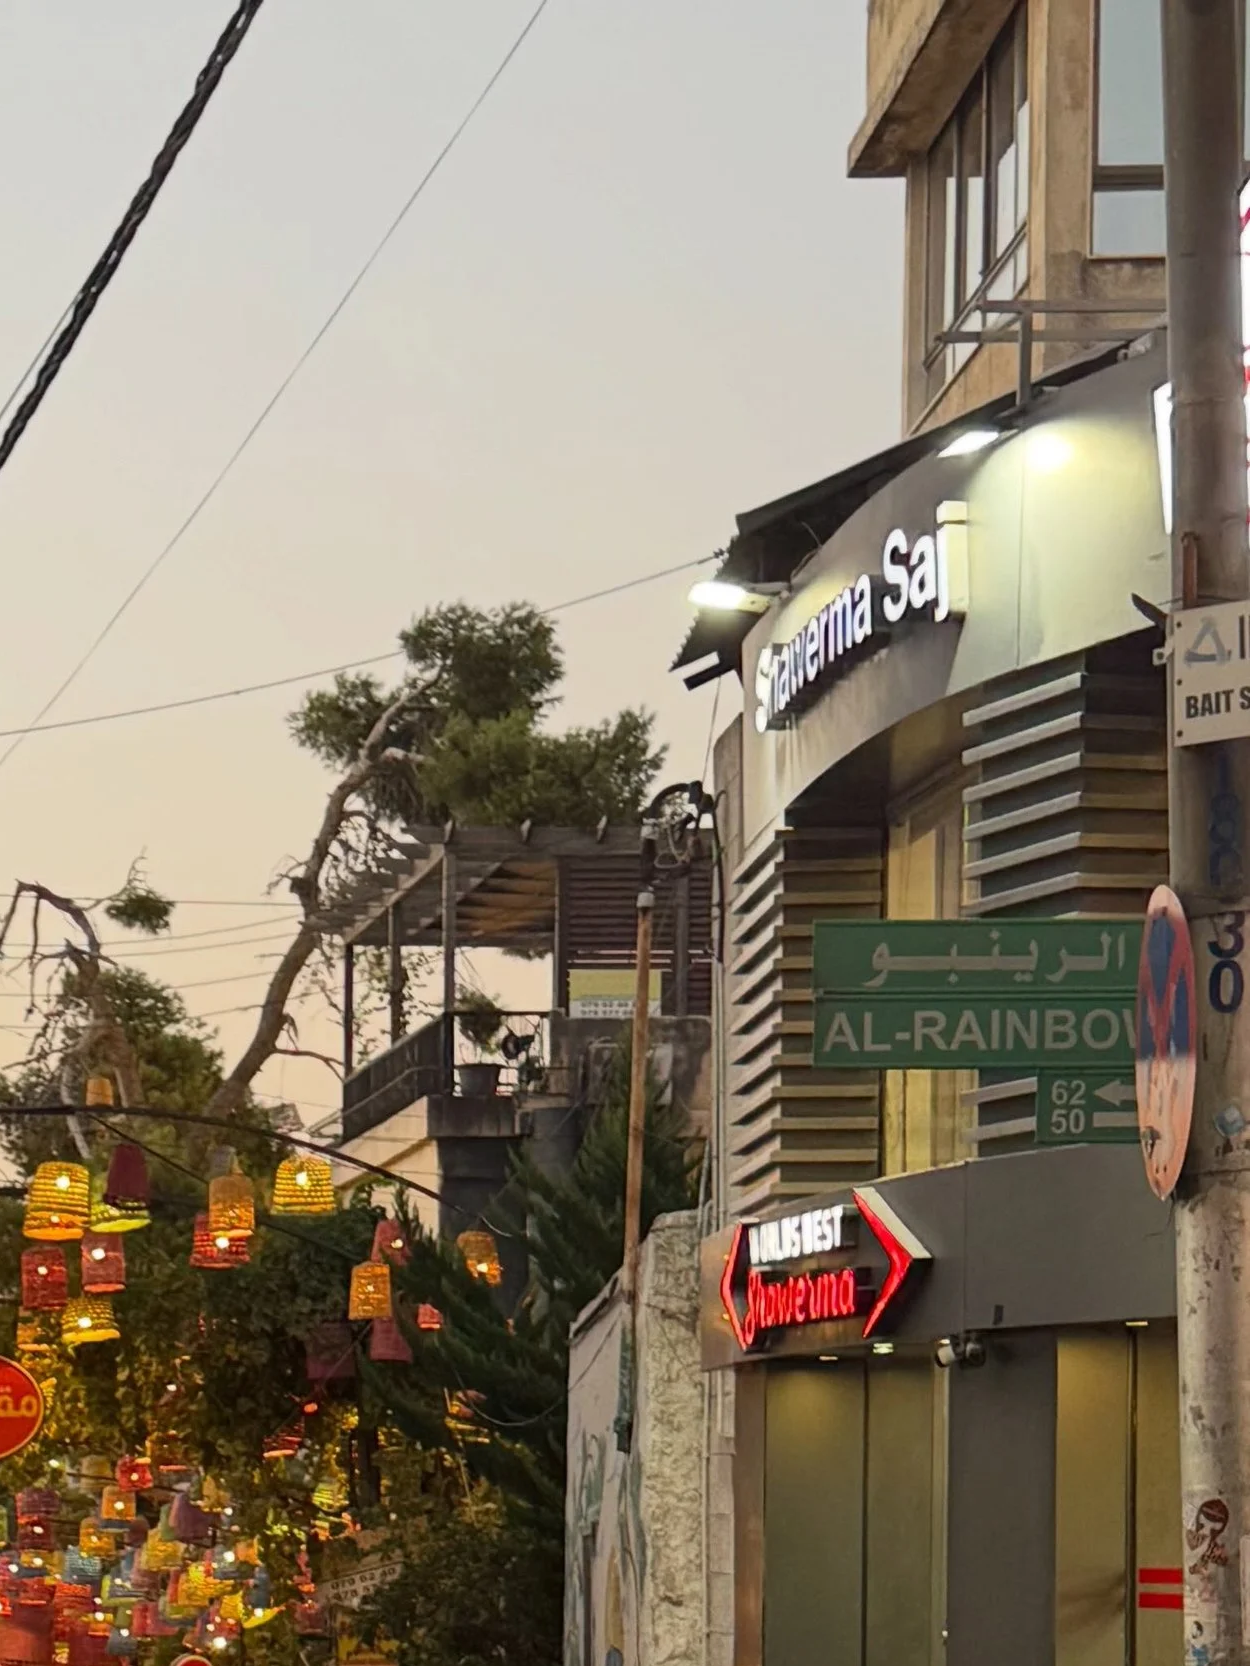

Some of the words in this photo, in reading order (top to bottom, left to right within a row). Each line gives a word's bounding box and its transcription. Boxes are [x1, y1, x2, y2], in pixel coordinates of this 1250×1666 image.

[755, 574, 873, 733] Shawerma
[882, 500, 954, 623] Saj
[1185, 688, 1235, 720] BAIT
[861, 929, 1127, 988] الرينبو
[822, 1008, 1137, 1052] AL-RAINBO
[1051, 1079, 1087, 1105] 62
[1050, 1109, 1085, 1135] 50
